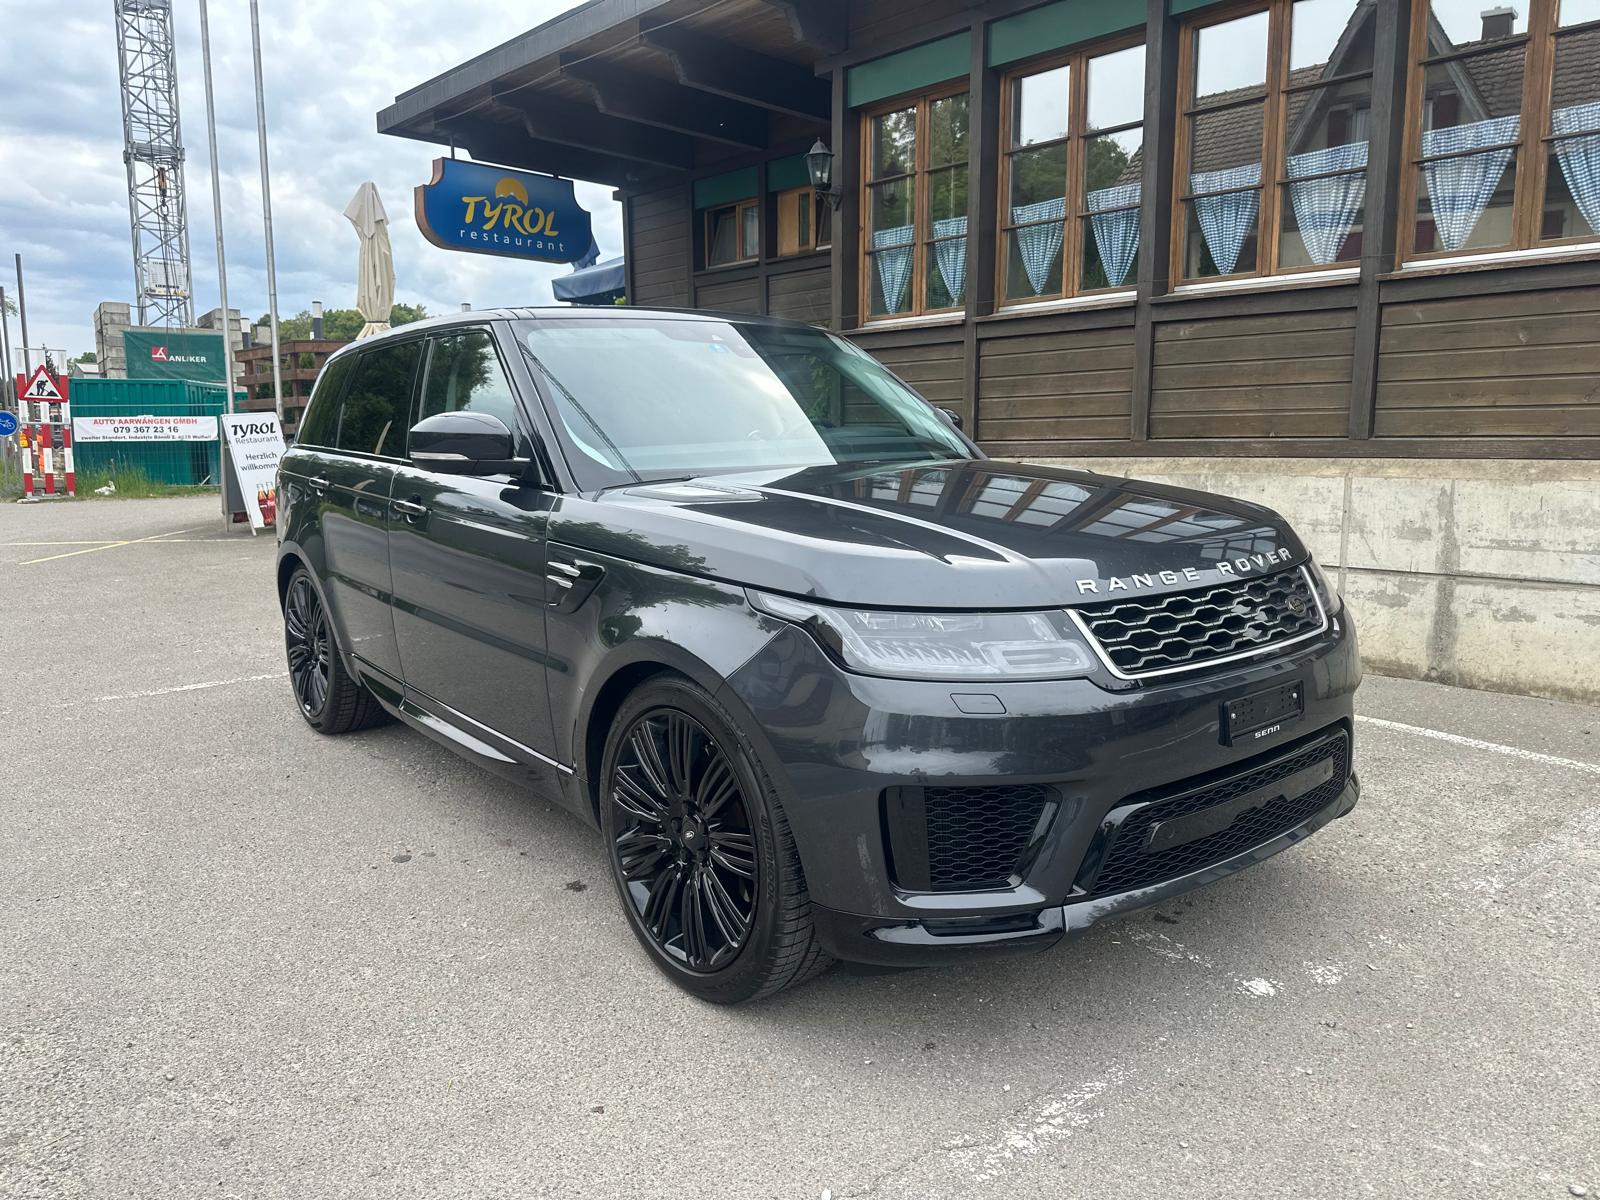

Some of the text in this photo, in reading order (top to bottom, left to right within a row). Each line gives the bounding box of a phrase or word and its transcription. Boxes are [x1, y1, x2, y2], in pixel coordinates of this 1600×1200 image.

[462, 196, 559, 237] TYROL
[460, 229, 565, 252] restaurant
[169, 355, 207, 363] ANLIKER
[231, 422, 276, 438] TYROL
[235, 435, 279, 445] Restaurant
[245, 452, 278, 461] Herzlich
[1076, 547, 1292, 595] RANGE ROVER
